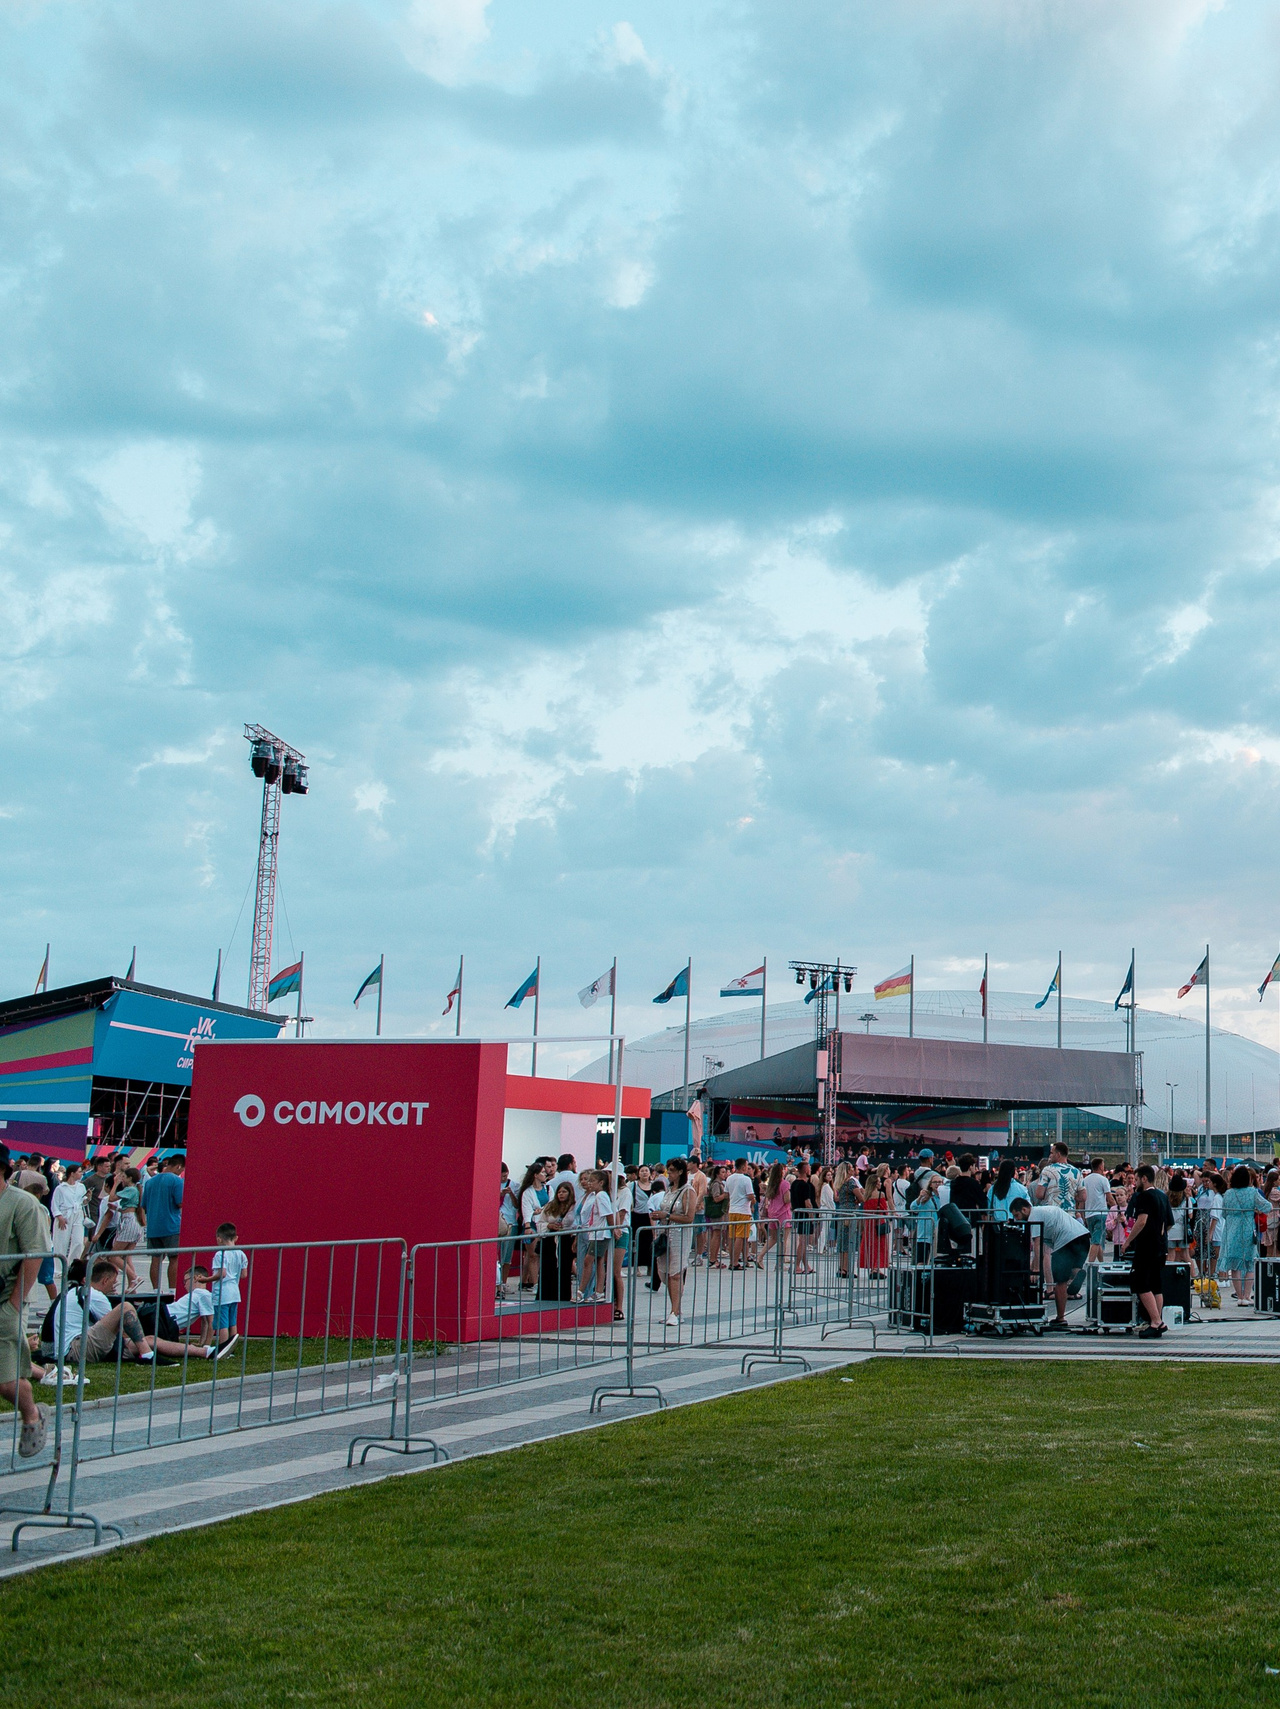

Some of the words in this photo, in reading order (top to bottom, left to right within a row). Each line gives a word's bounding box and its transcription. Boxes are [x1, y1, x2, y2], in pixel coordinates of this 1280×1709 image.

[197, 1016, 217, 1036] VK
[866, 1112, 890, 1126] VK
[746, 1150, 770, 1167] VK
